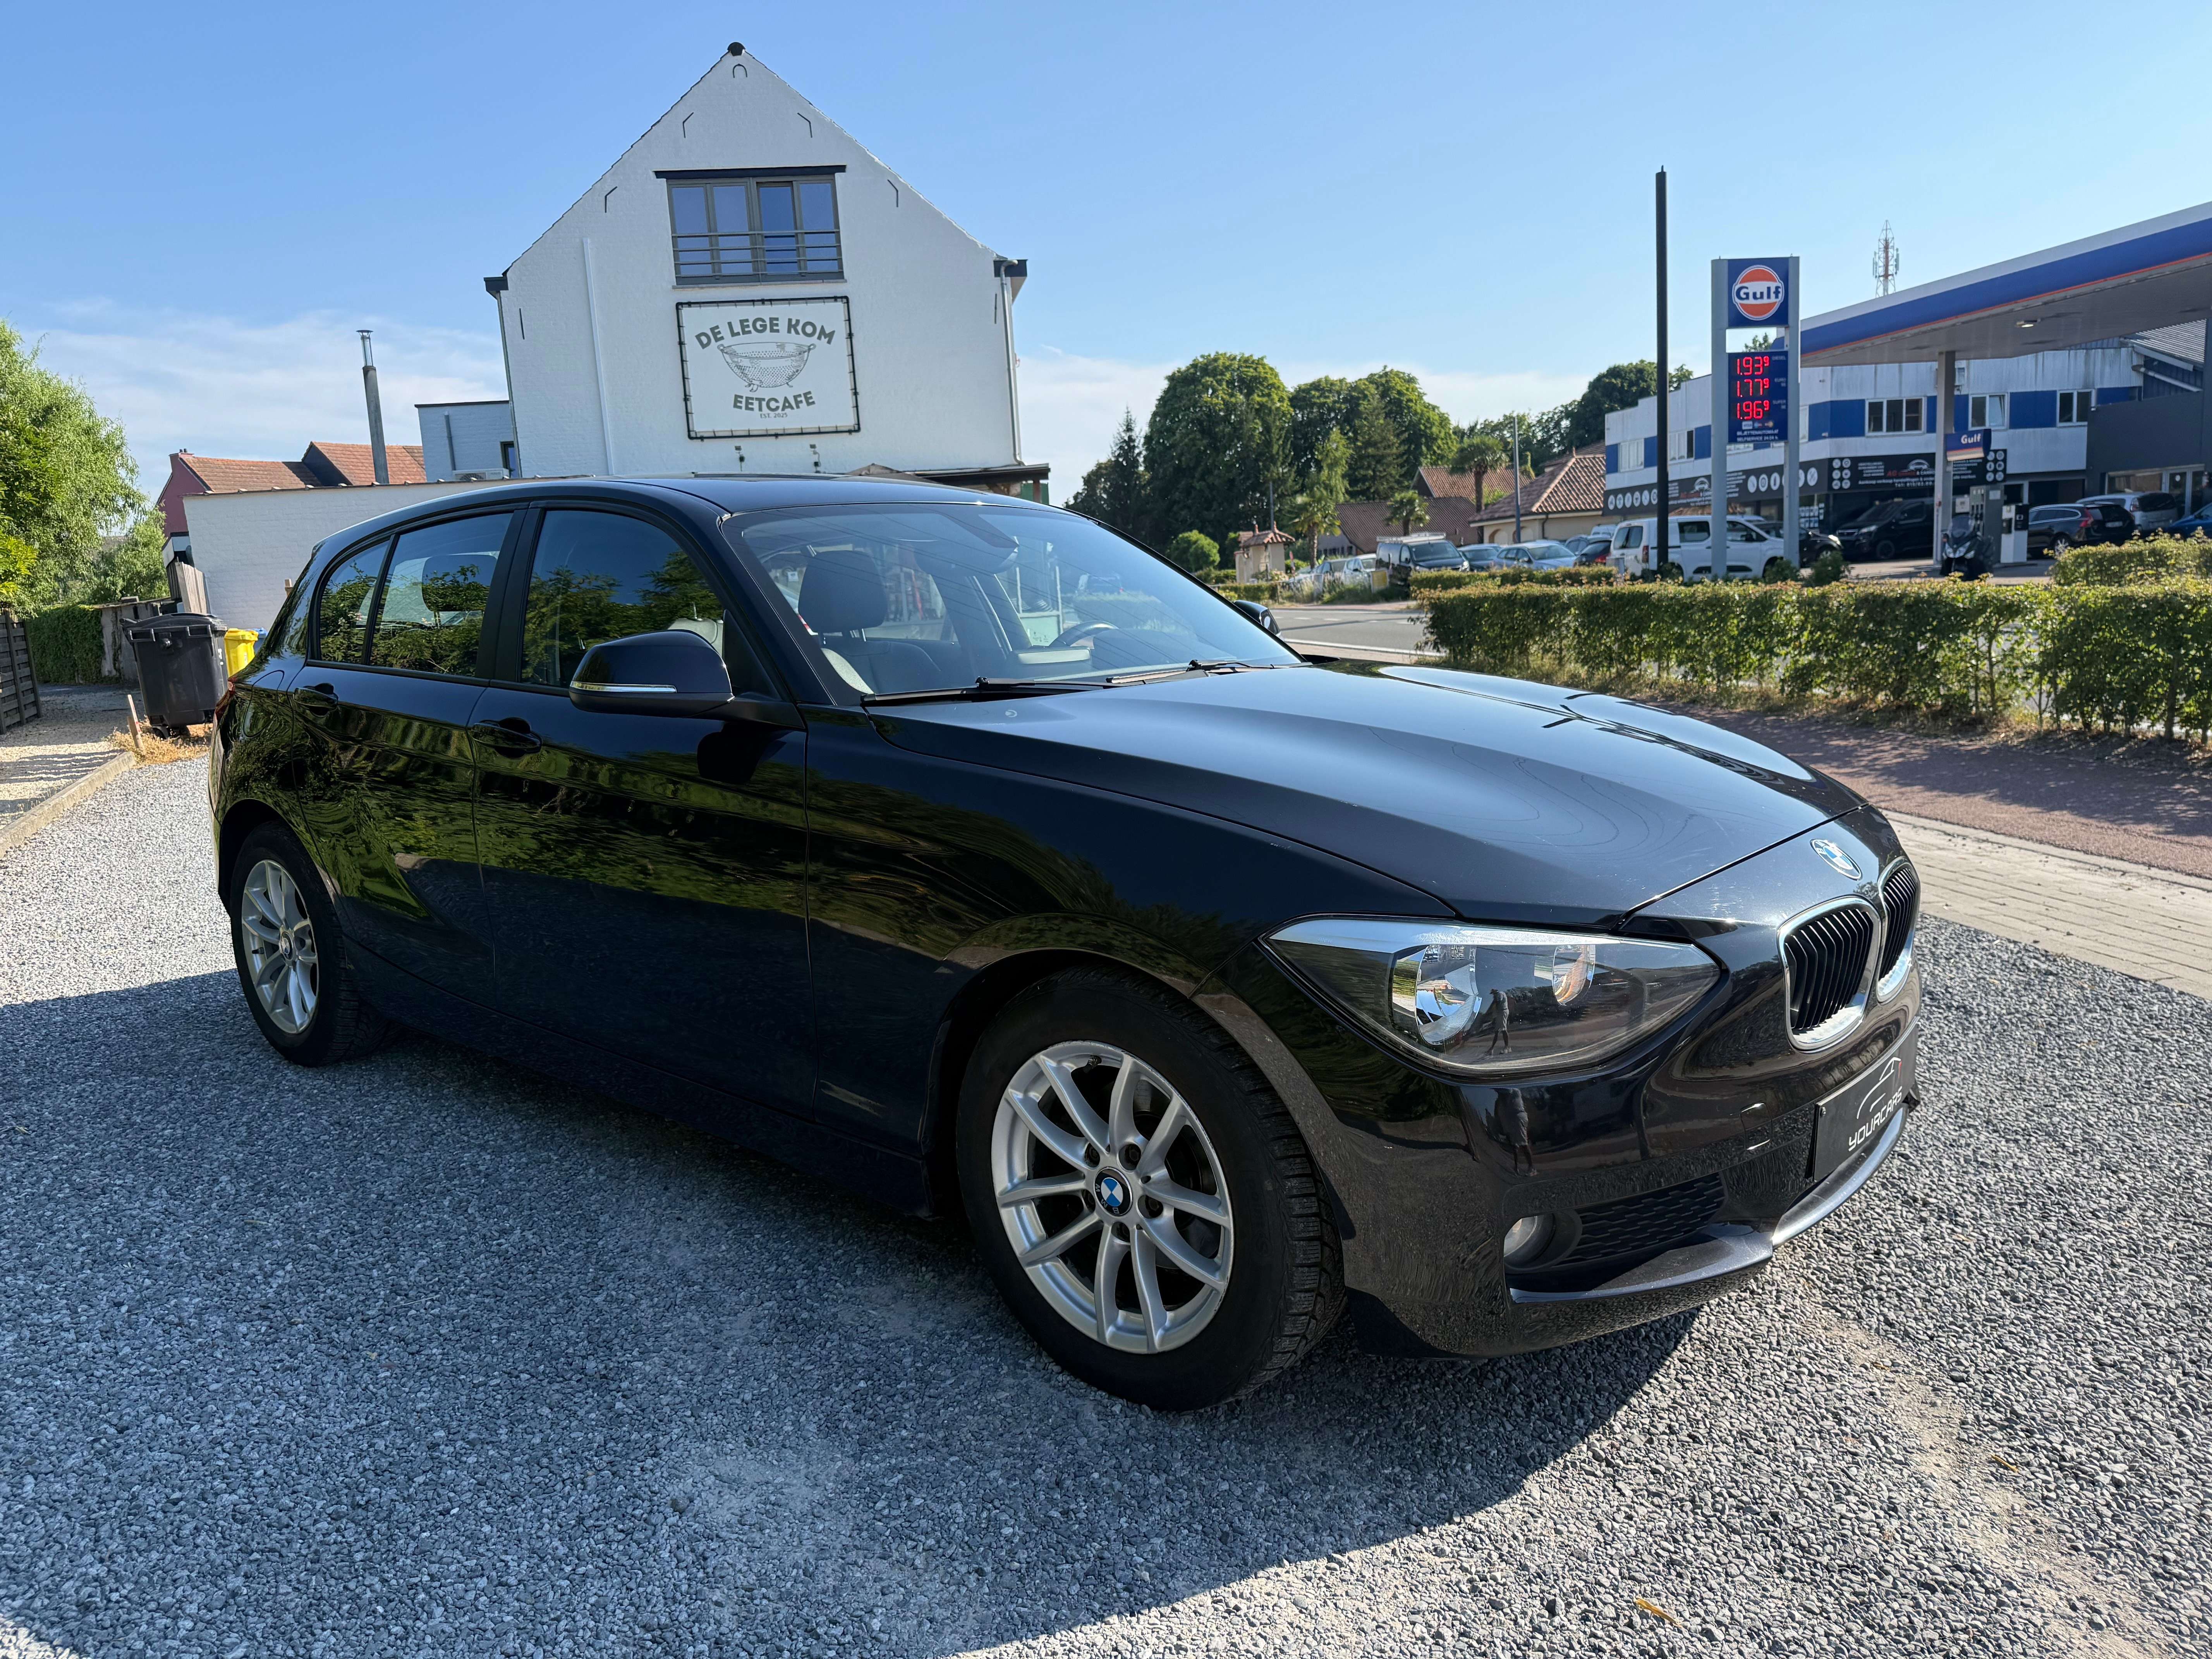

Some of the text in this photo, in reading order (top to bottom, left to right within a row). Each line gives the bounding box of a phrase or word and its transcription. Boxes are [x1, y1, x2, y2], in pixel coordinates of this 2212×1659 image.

[1735, 286, 1781, 301] Gulf
[695, 317, 835, 350] DE LEGE KOM
[733, 391, 816, 412] EETCAFE
[1961, 433, 1981, 444] Gulf
[1848, 1086, 1902, 1151] YOURCARS
